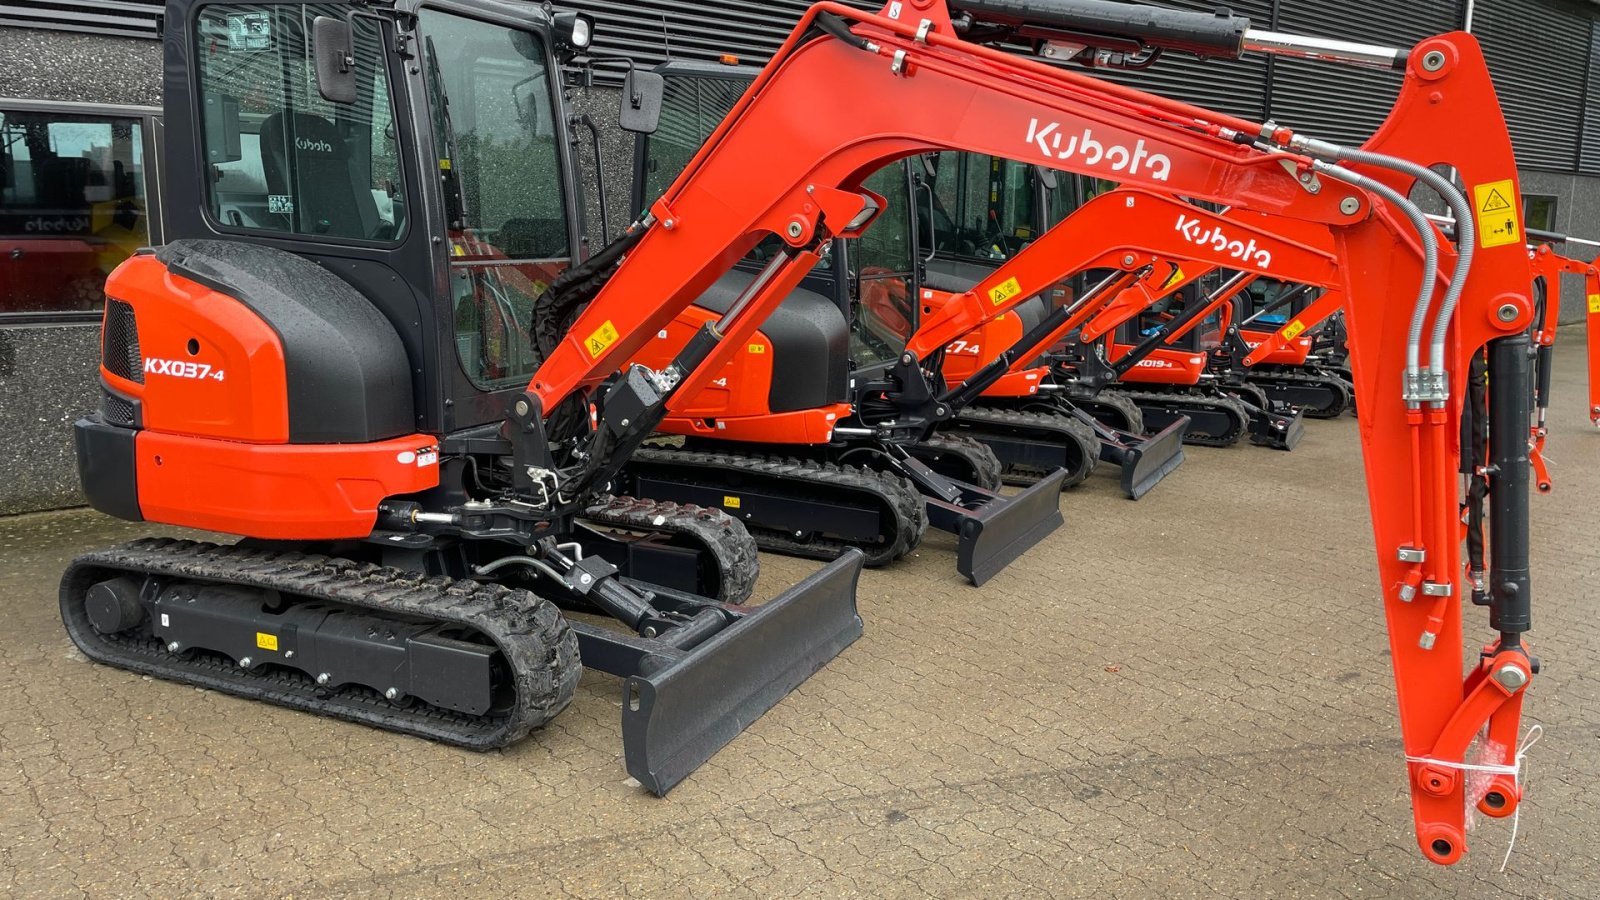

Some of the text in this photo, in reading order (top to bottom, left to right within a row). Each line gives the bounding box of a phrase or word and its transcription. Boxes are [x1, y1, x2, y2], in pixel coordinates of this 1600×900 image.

[295, 136, 333, 153] Kubota
[1026, 118, 1171, 181] Kubota
[1175, 214, 1272, 269] Kubota
[144, 357, 225, 382] KX037-4
[1134, 359, 1173, 369] X019-4
